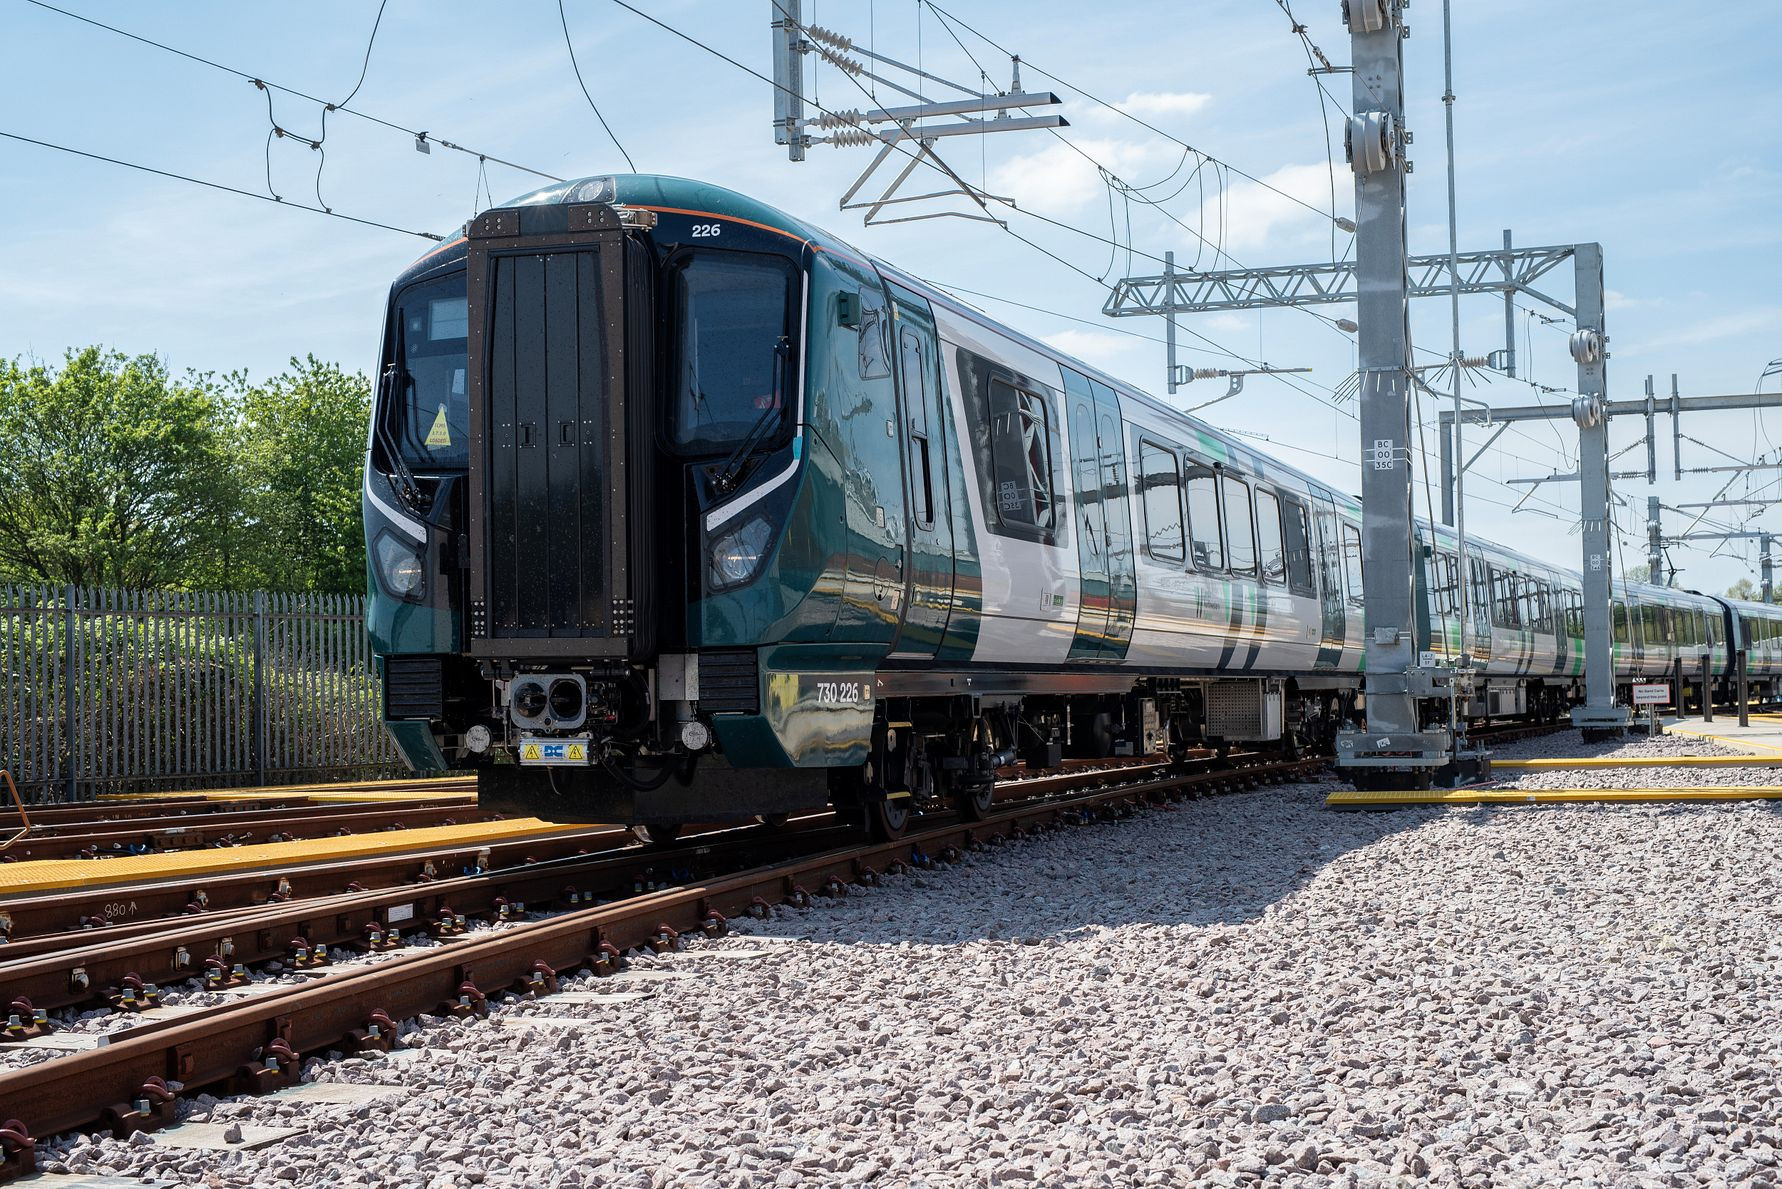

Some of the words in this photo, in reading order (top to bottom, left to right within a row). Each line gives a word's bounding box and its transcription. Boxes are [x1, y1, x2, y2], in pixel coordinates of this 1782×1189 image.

[692, 224, 720, 237] 226
[1377, 450, 1390, 459] 00
[1375, 461, 1392, 469] 35C
[817, 682, 838, 703] 730
[840, 682, 859, 703] 226
[105, 902, 126, 918] 880
